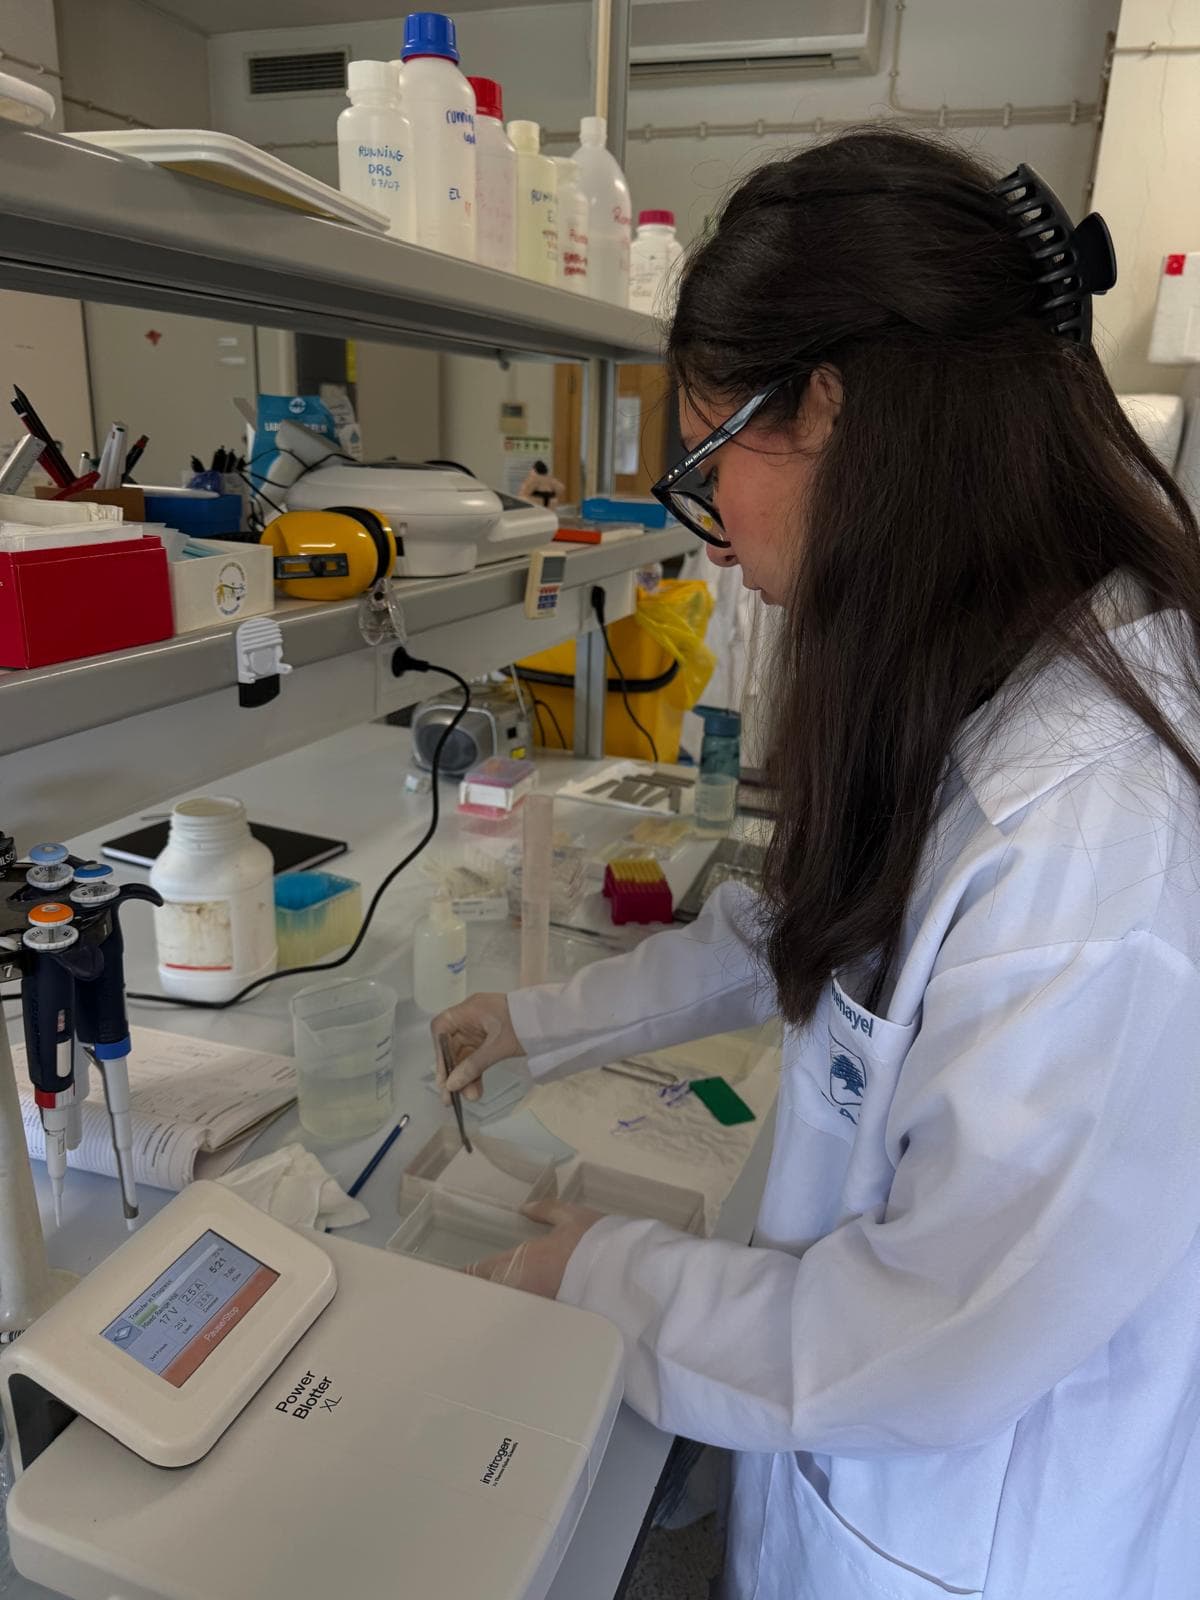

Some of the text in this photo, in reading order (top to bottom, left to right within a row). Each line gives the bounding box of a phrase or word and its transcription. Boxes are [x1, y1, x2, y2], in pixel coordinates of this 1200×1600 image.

[3, 964, 14, 978] 7
[275, 1370, 315, 1413] Power
[292, 1376, 332, 1419] Blotter
[319, 1396, 343, 1412] XL
[480, 1437, 512, 1484] invitrogen
